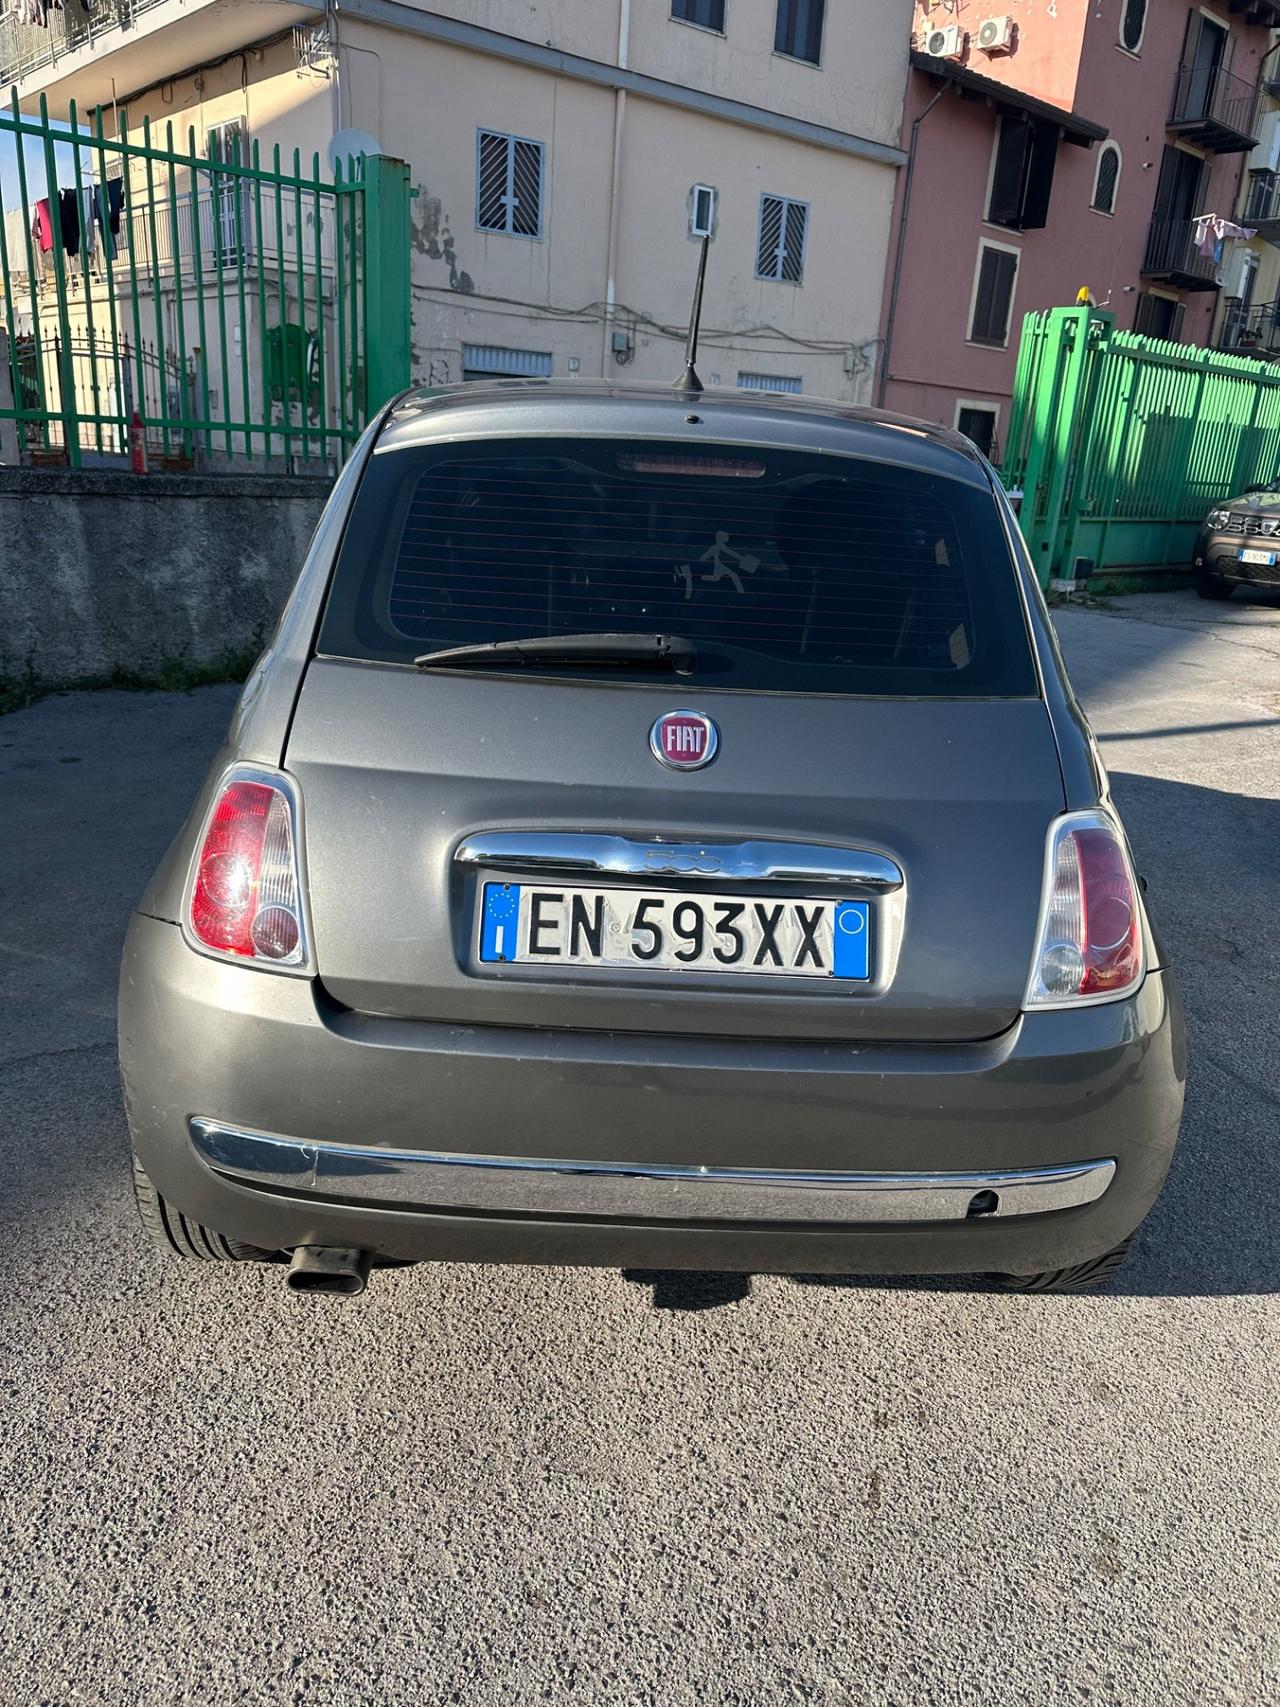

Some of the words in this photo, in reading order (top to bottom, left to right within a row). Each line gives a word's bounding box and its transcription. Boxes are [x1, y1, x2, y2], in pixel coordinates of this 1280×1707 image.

[666, 725, 705, 753] FIAT
[644, 849, 723, 874] 500
[528, 892, 604, 957] EN
[630, 898, 826, 968] 593XX
